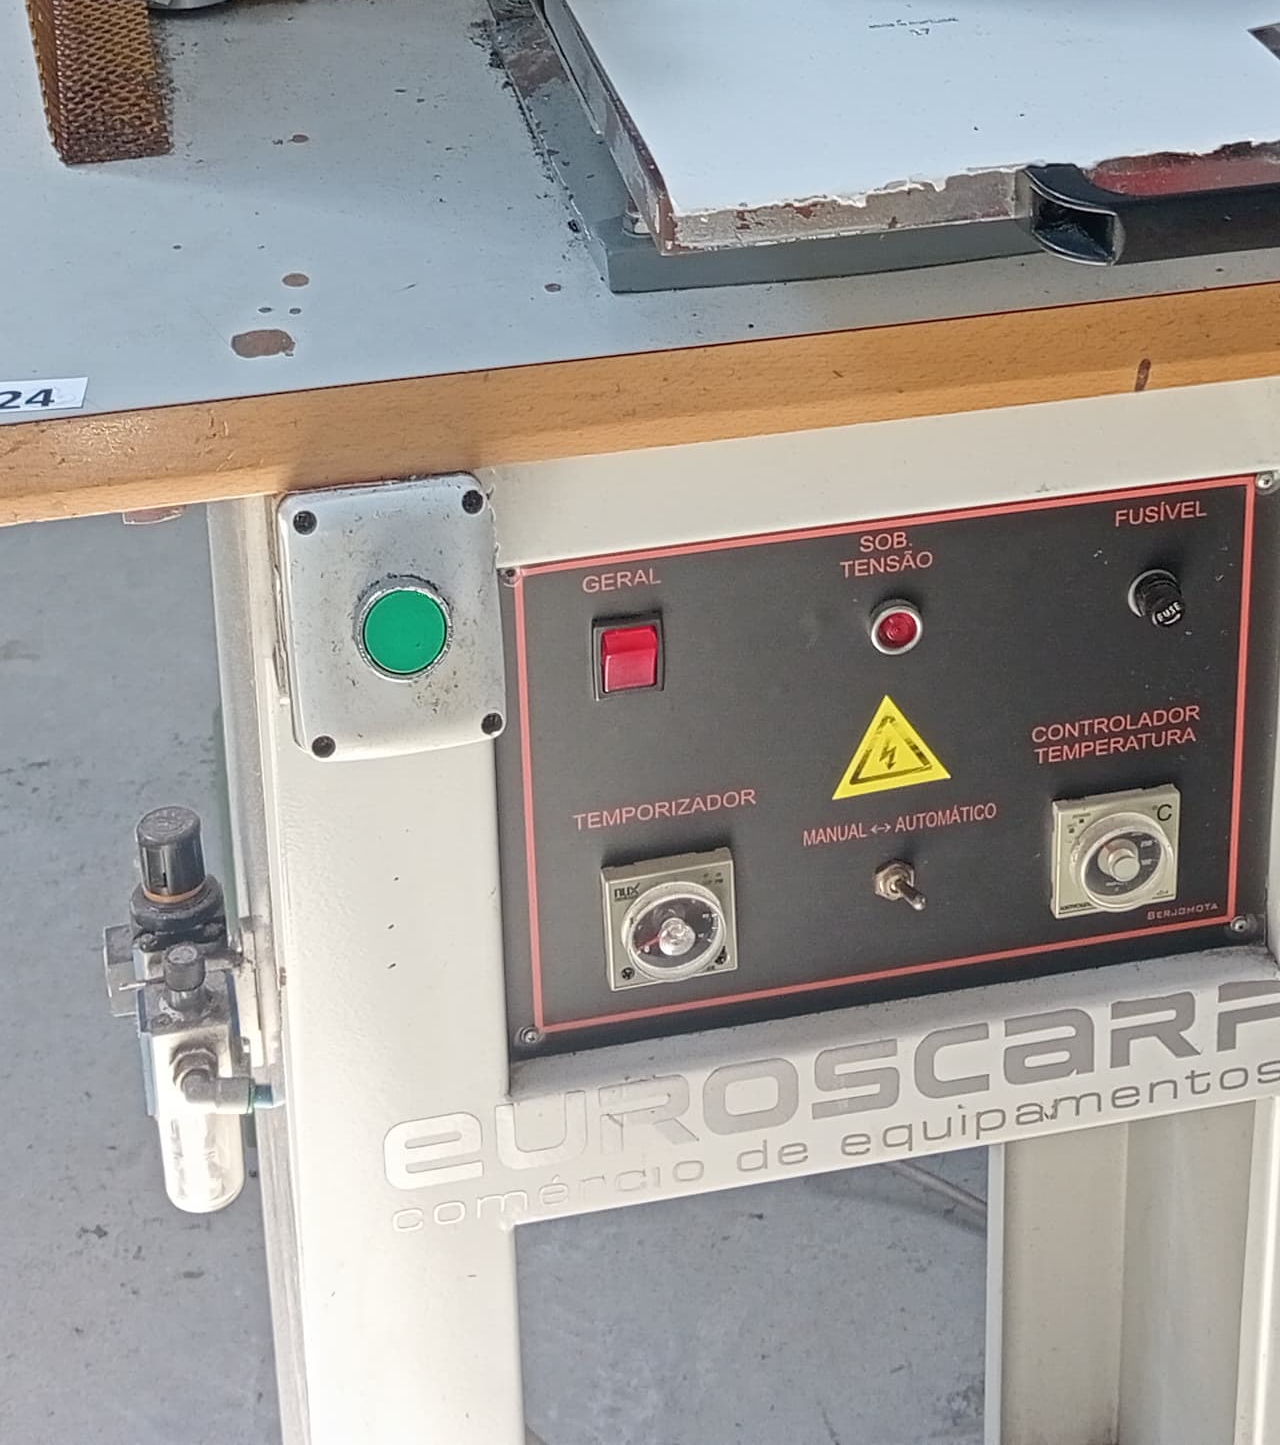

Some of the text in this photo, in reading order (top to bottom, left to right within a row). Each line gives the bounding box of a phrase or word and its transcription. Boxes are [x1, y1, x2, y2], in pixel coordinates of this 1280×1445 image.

[1115, 501, 1207, 527] FUSÍVEL
[860, 532, 913, 553] SOB.
[582, 568, 661, 594] GERAL
[840, 550, 934, 579] TENSÃO
[1156, 601, 1181, 623] FUSE
[1031, 705, 1201, 743] CONTROLADOR
[1034, 727, 1197, 764] TEMPERATURA
[573, 788, 757, 830] TEMPORIZADOR
[803, 803, 998, 847] MANUAL AUTOMÁTICO
[391, 1160, 705, 1233] comércio
[736, 1139, 810, 1173] de
